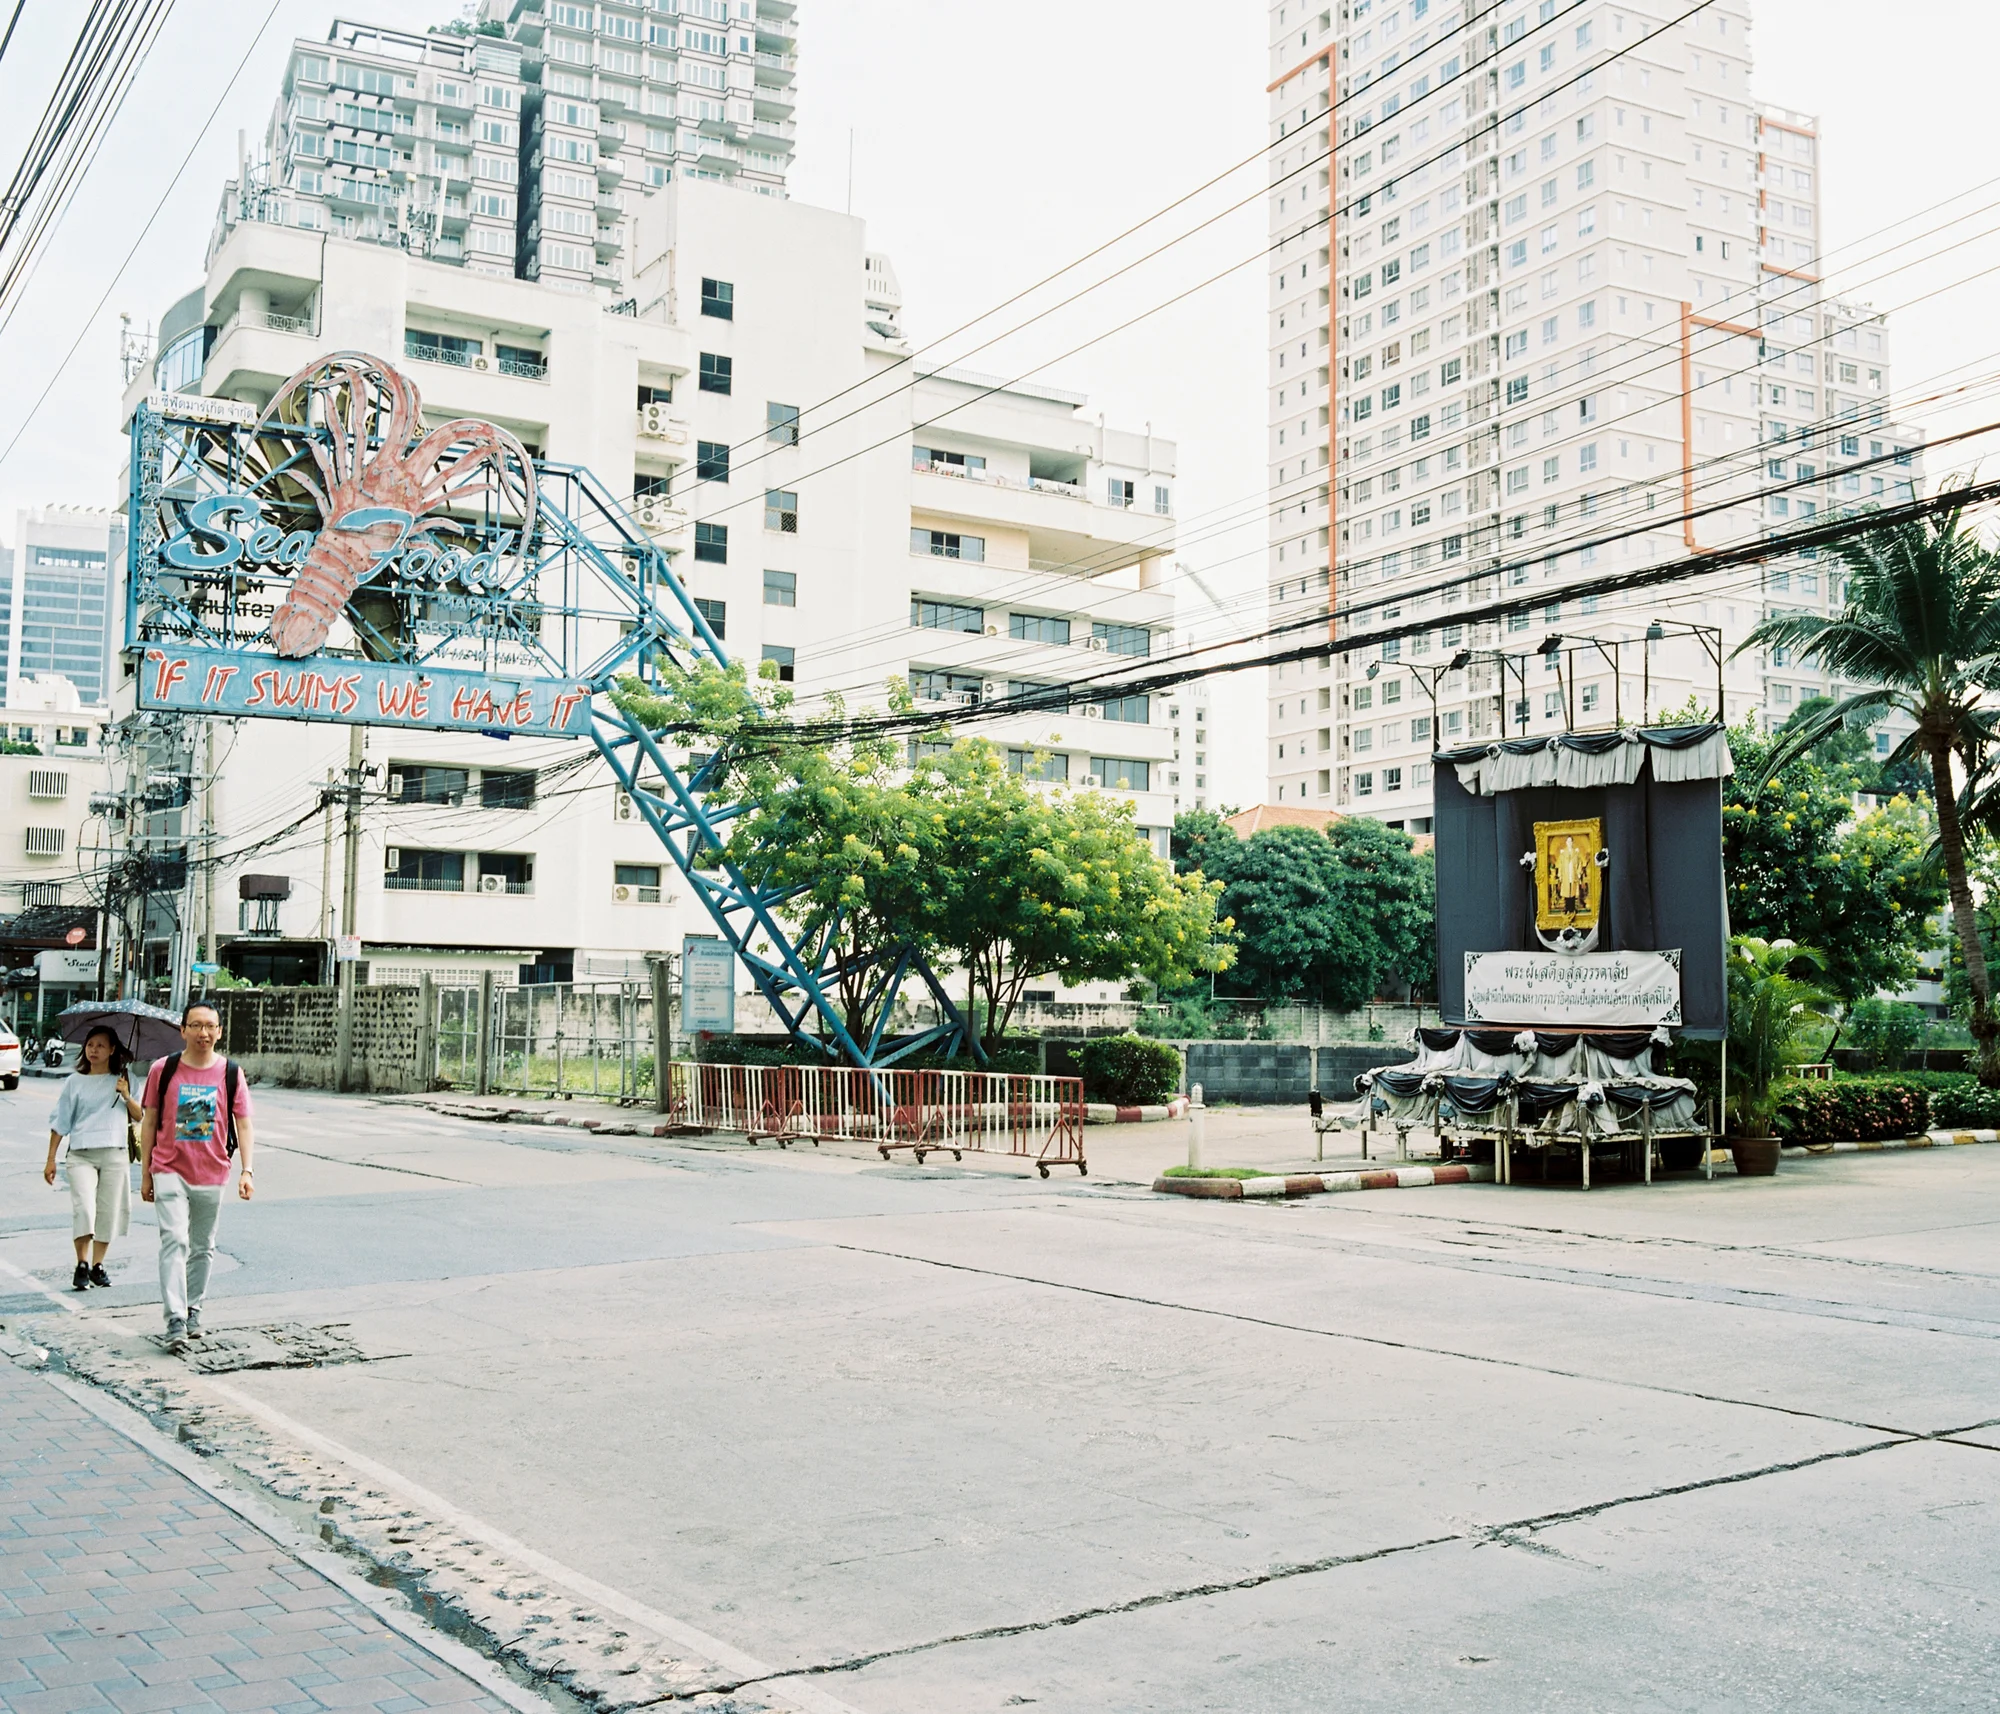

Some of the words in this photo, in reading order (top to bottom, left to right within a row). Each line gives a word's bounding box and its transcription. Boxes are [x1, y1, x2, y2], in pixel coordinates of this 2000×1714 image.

[165, 494, 315, 569] Sea
[335, 506, 515, 588] Food
[437, 595, 517, 616] MARKET
[415, 619, 537, 648] RESTAURANT
[201, 665, 240, 704] IT
[244, 669, 363, 716] SWIMS
[376, 679, 434, 720] WE
[451, 686, 534, 727] HAVE
